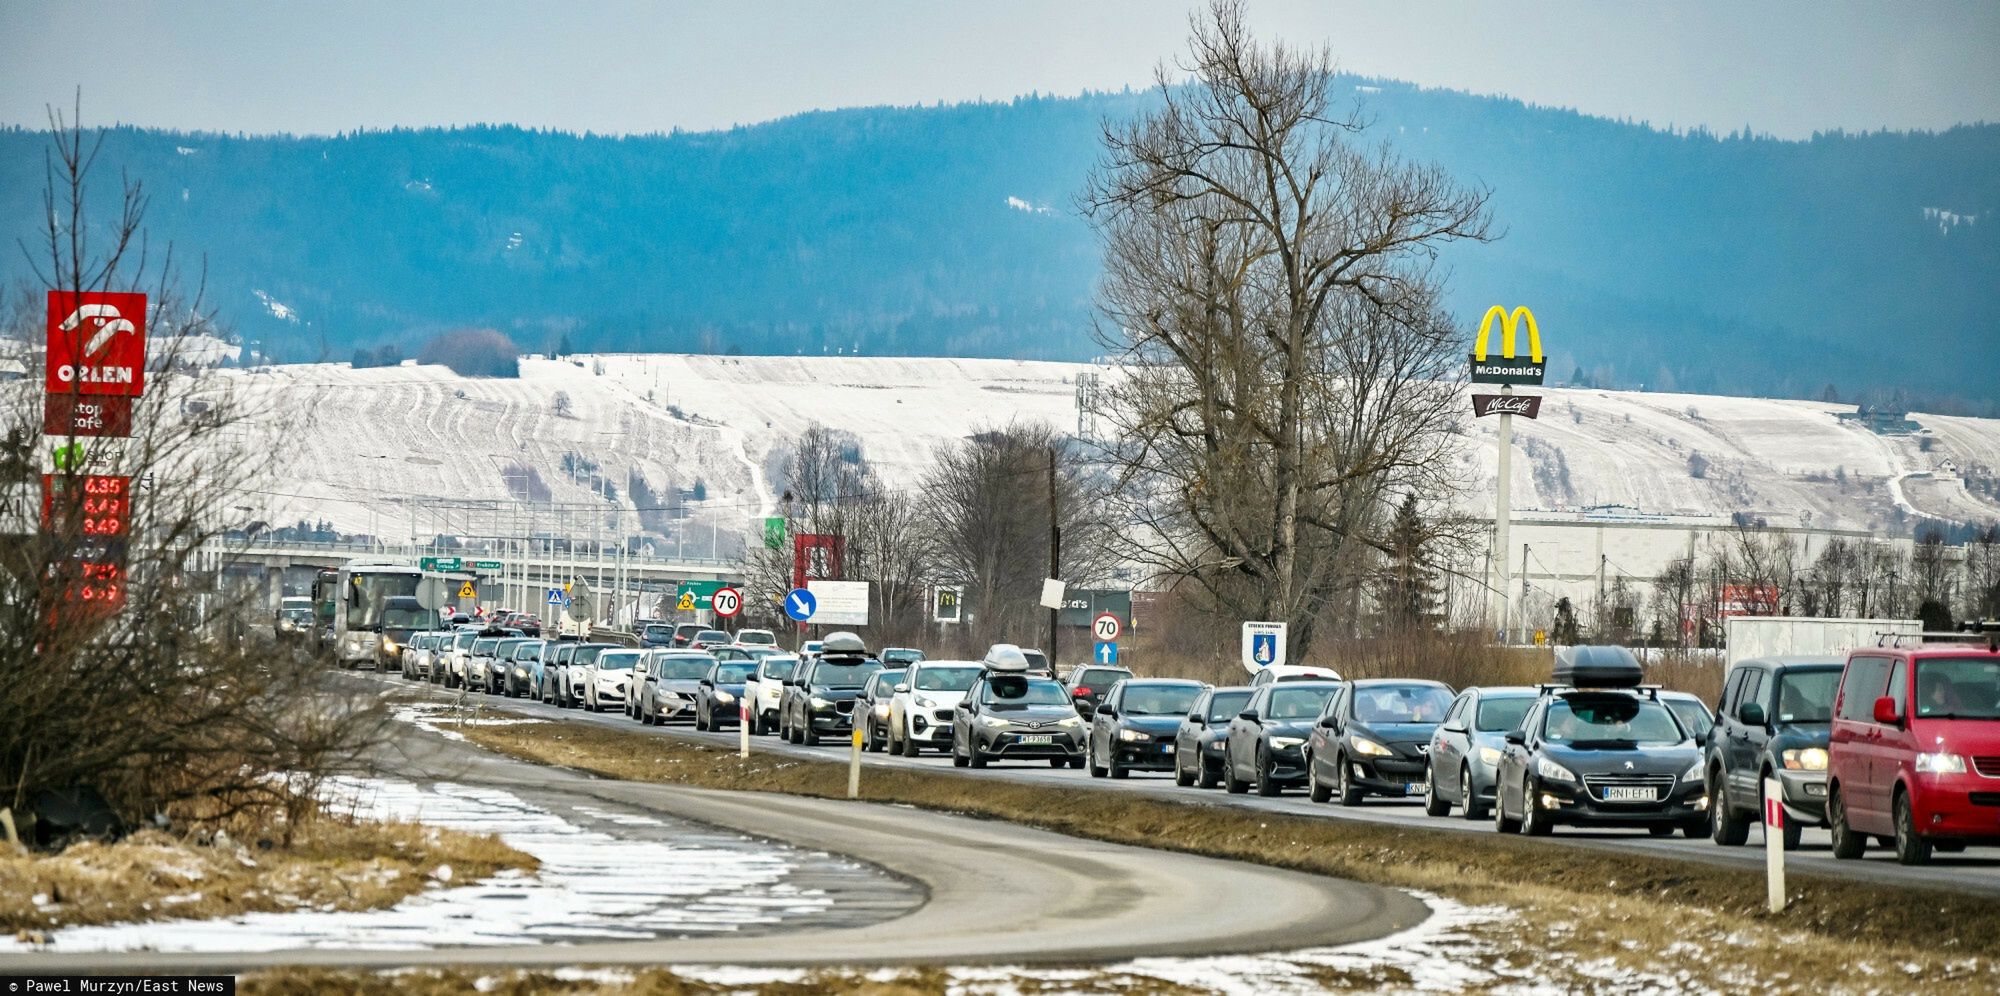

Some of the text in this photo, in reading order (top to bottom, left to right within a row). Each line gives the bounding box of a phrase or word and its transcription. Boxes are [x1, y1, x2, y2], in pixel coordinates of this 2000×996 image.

[57, 364, 132, 384] ORLEN
[1475, 365, 1542, 377] McDonald's
[73, 402, 103, 417] top
[84, 478, 121, 494] 6.35
[717, 595, 737, 610] 70
[1098, 621, 1116, 635] 70
